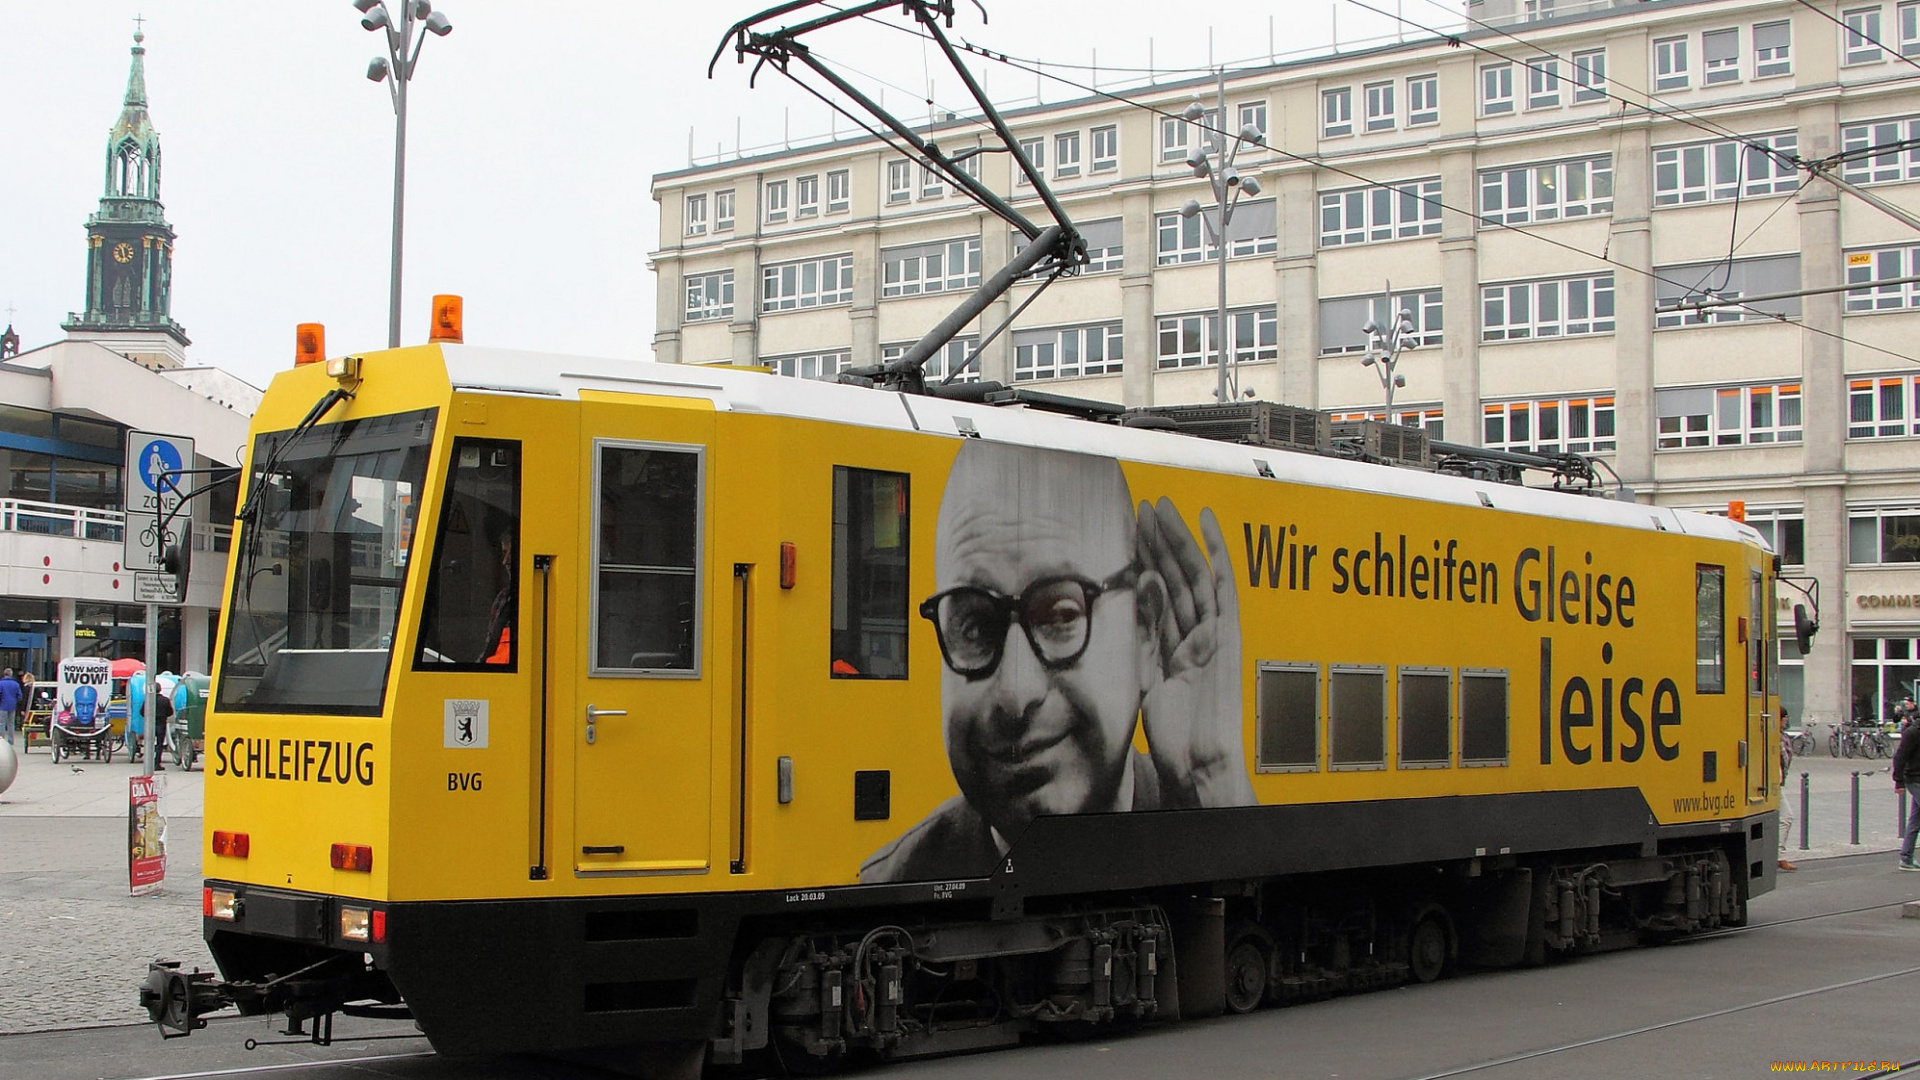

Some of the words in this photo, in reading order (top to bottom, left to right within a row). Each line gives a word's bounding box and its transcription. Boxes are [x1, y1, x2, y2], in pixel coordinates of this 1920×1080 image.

[143, 495, 176, 510] ZONE
[1243, 522, 1317, 591] Wir
[1332, 531, 1498, 604] schleifen
[1513, 545, 1635, 628] Gleise
[64, 665, 85, 673] NOW
[64, 672, 109, 685] WOW!
[1540, 637, 1681, 765] leise
[215, 736, 374, 786] SCHLEIFZUG
[447, 772, 482, 791] BVG
[1673, 789, 1735, 816] www.bvg.de
